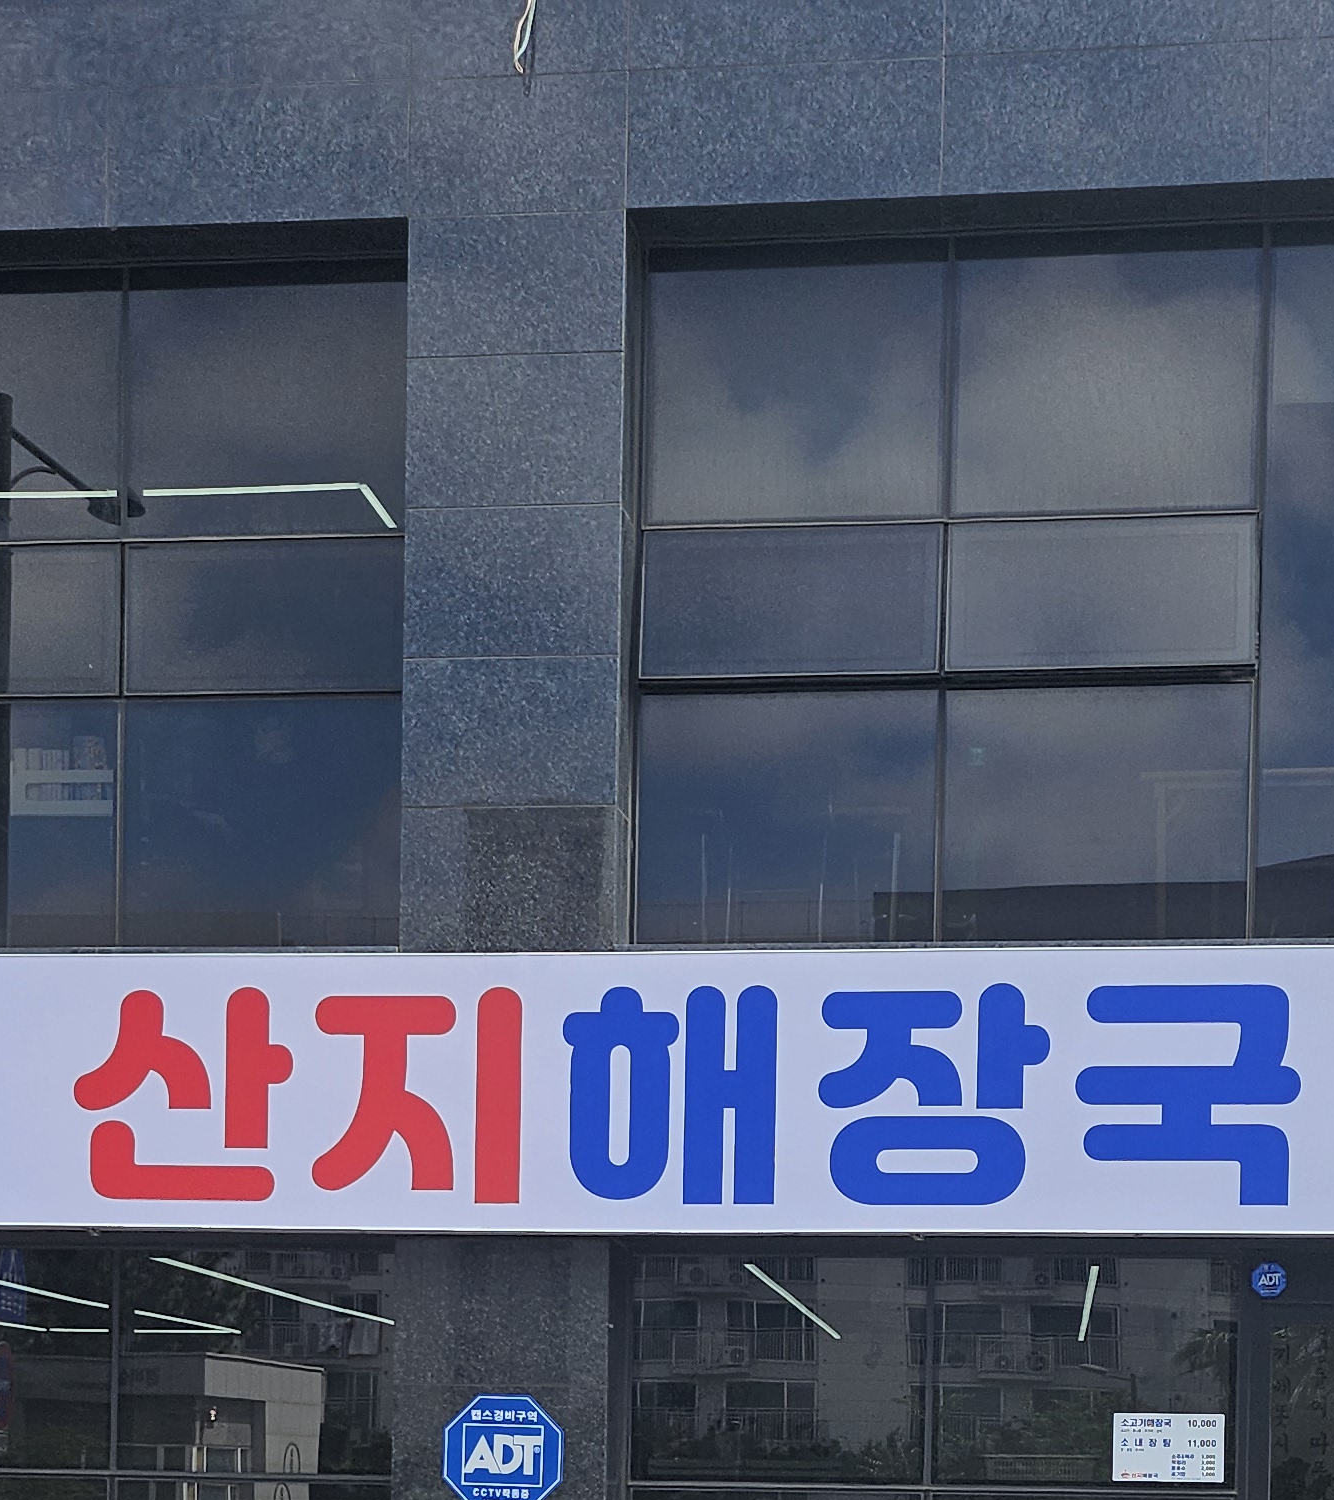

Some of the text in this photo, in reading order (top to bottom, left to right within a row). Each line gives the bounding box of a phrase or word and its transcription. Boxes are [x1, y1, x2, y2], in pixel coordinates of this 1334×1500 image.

[73, 983, 1302, 1205] 산지해장국
[1257, 1273, 1282, 1286] ADT
[1120, 1418, 1217, 1429] 소고기해장국 10,000
[1187, 1439, 1217, 1448] 11,000
[464, 1434, 542, 1475] ADT
